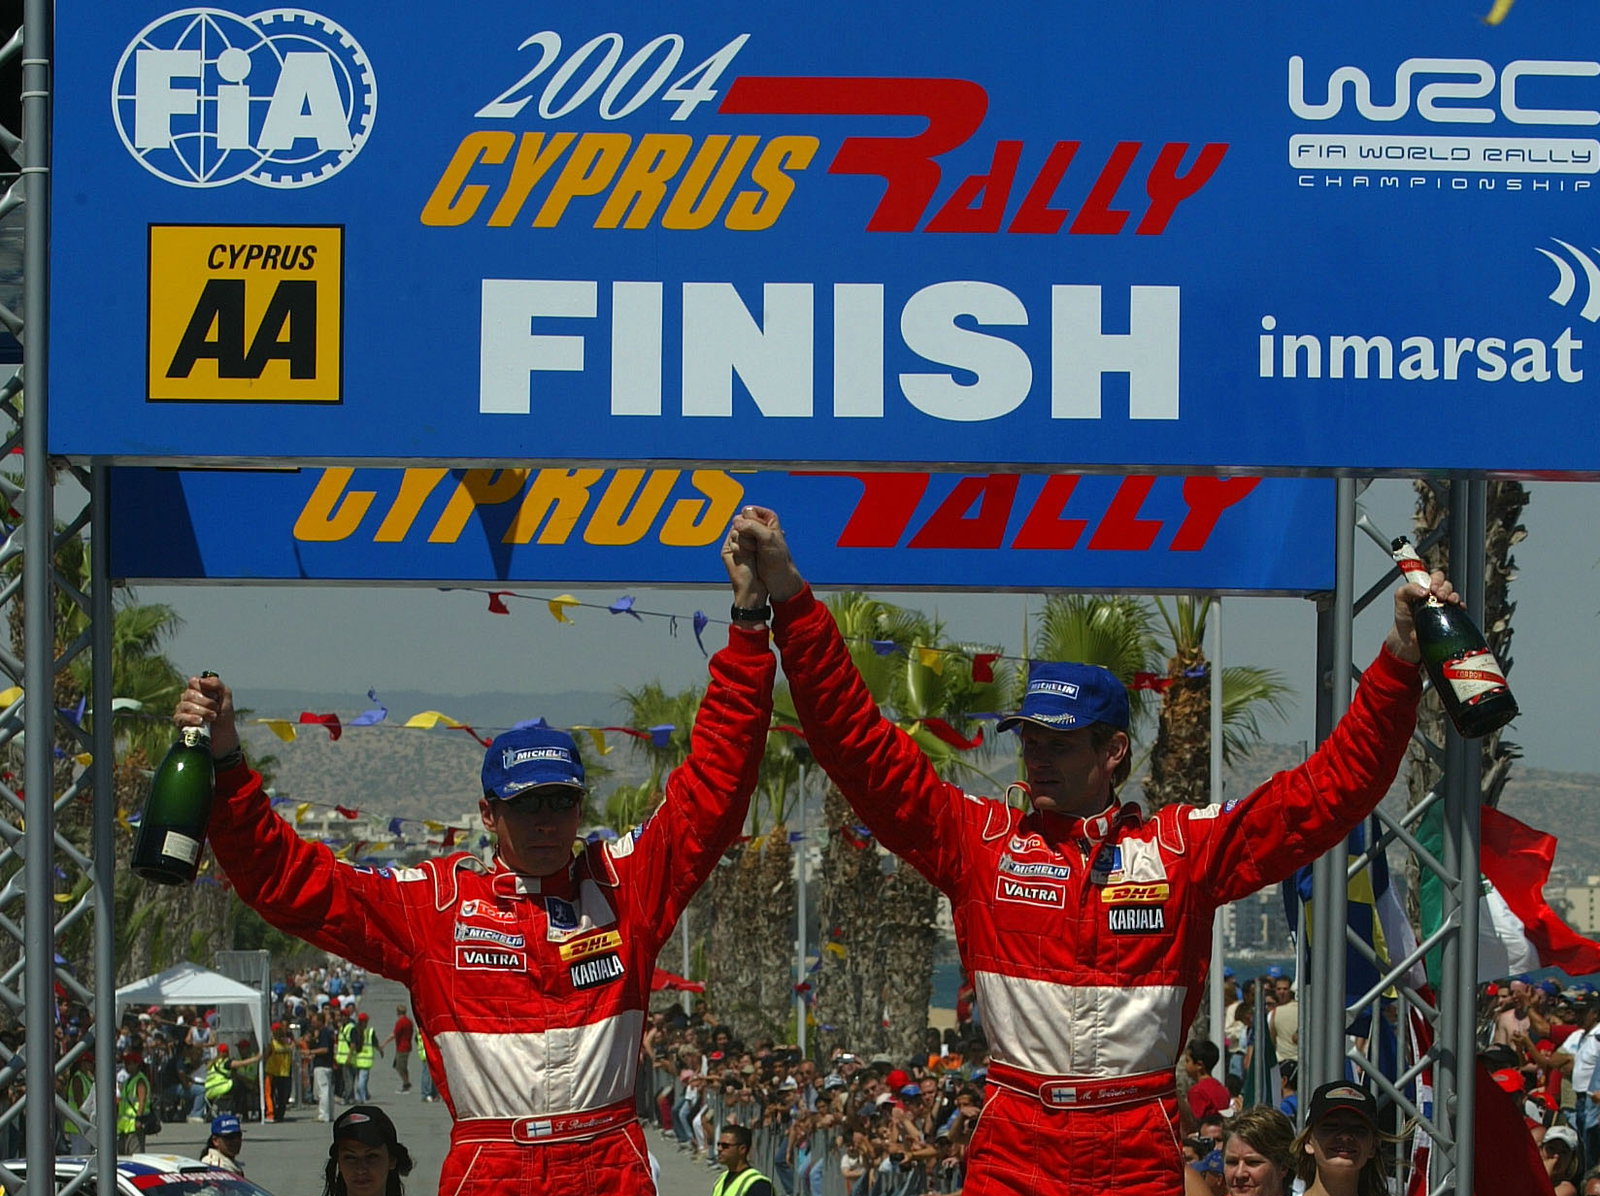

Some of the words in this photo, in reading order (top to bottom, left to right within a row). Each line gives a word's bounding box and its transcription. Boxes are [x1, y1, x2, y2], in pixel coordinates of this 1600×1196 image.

[474, 30, 750, 121] 2004
[1288, 55, 1600, 126] WRC
[420, 131, 819, 231] CYPRUS
[717, 76, 1230, 235] RALLY
[1298, 145, 1346, 158] FIA
[1359, 145, 1471, 161] WORLD
[1483, 148, 1591, 163] RALLY
[1298, 175, 1591, 192] CHAMPIONSHIP
[207, 243, 318, 271] CYPRUS
[165, 279, 318, 380] AA
[479, 279, 1181, 422] FINISH
[1259, 315, 1583, 383] inmarsat
[1012, 864, 1068, 878] MICHELIN
[1004, 882, 1058, 901] VALTRA
[1112, 887, 1160, 900] DHL
[1109, 908, 1164, 930] KARJALA
[570, 935, 612, 956] DHL
[463, 951, 519, 966] VALTRA
